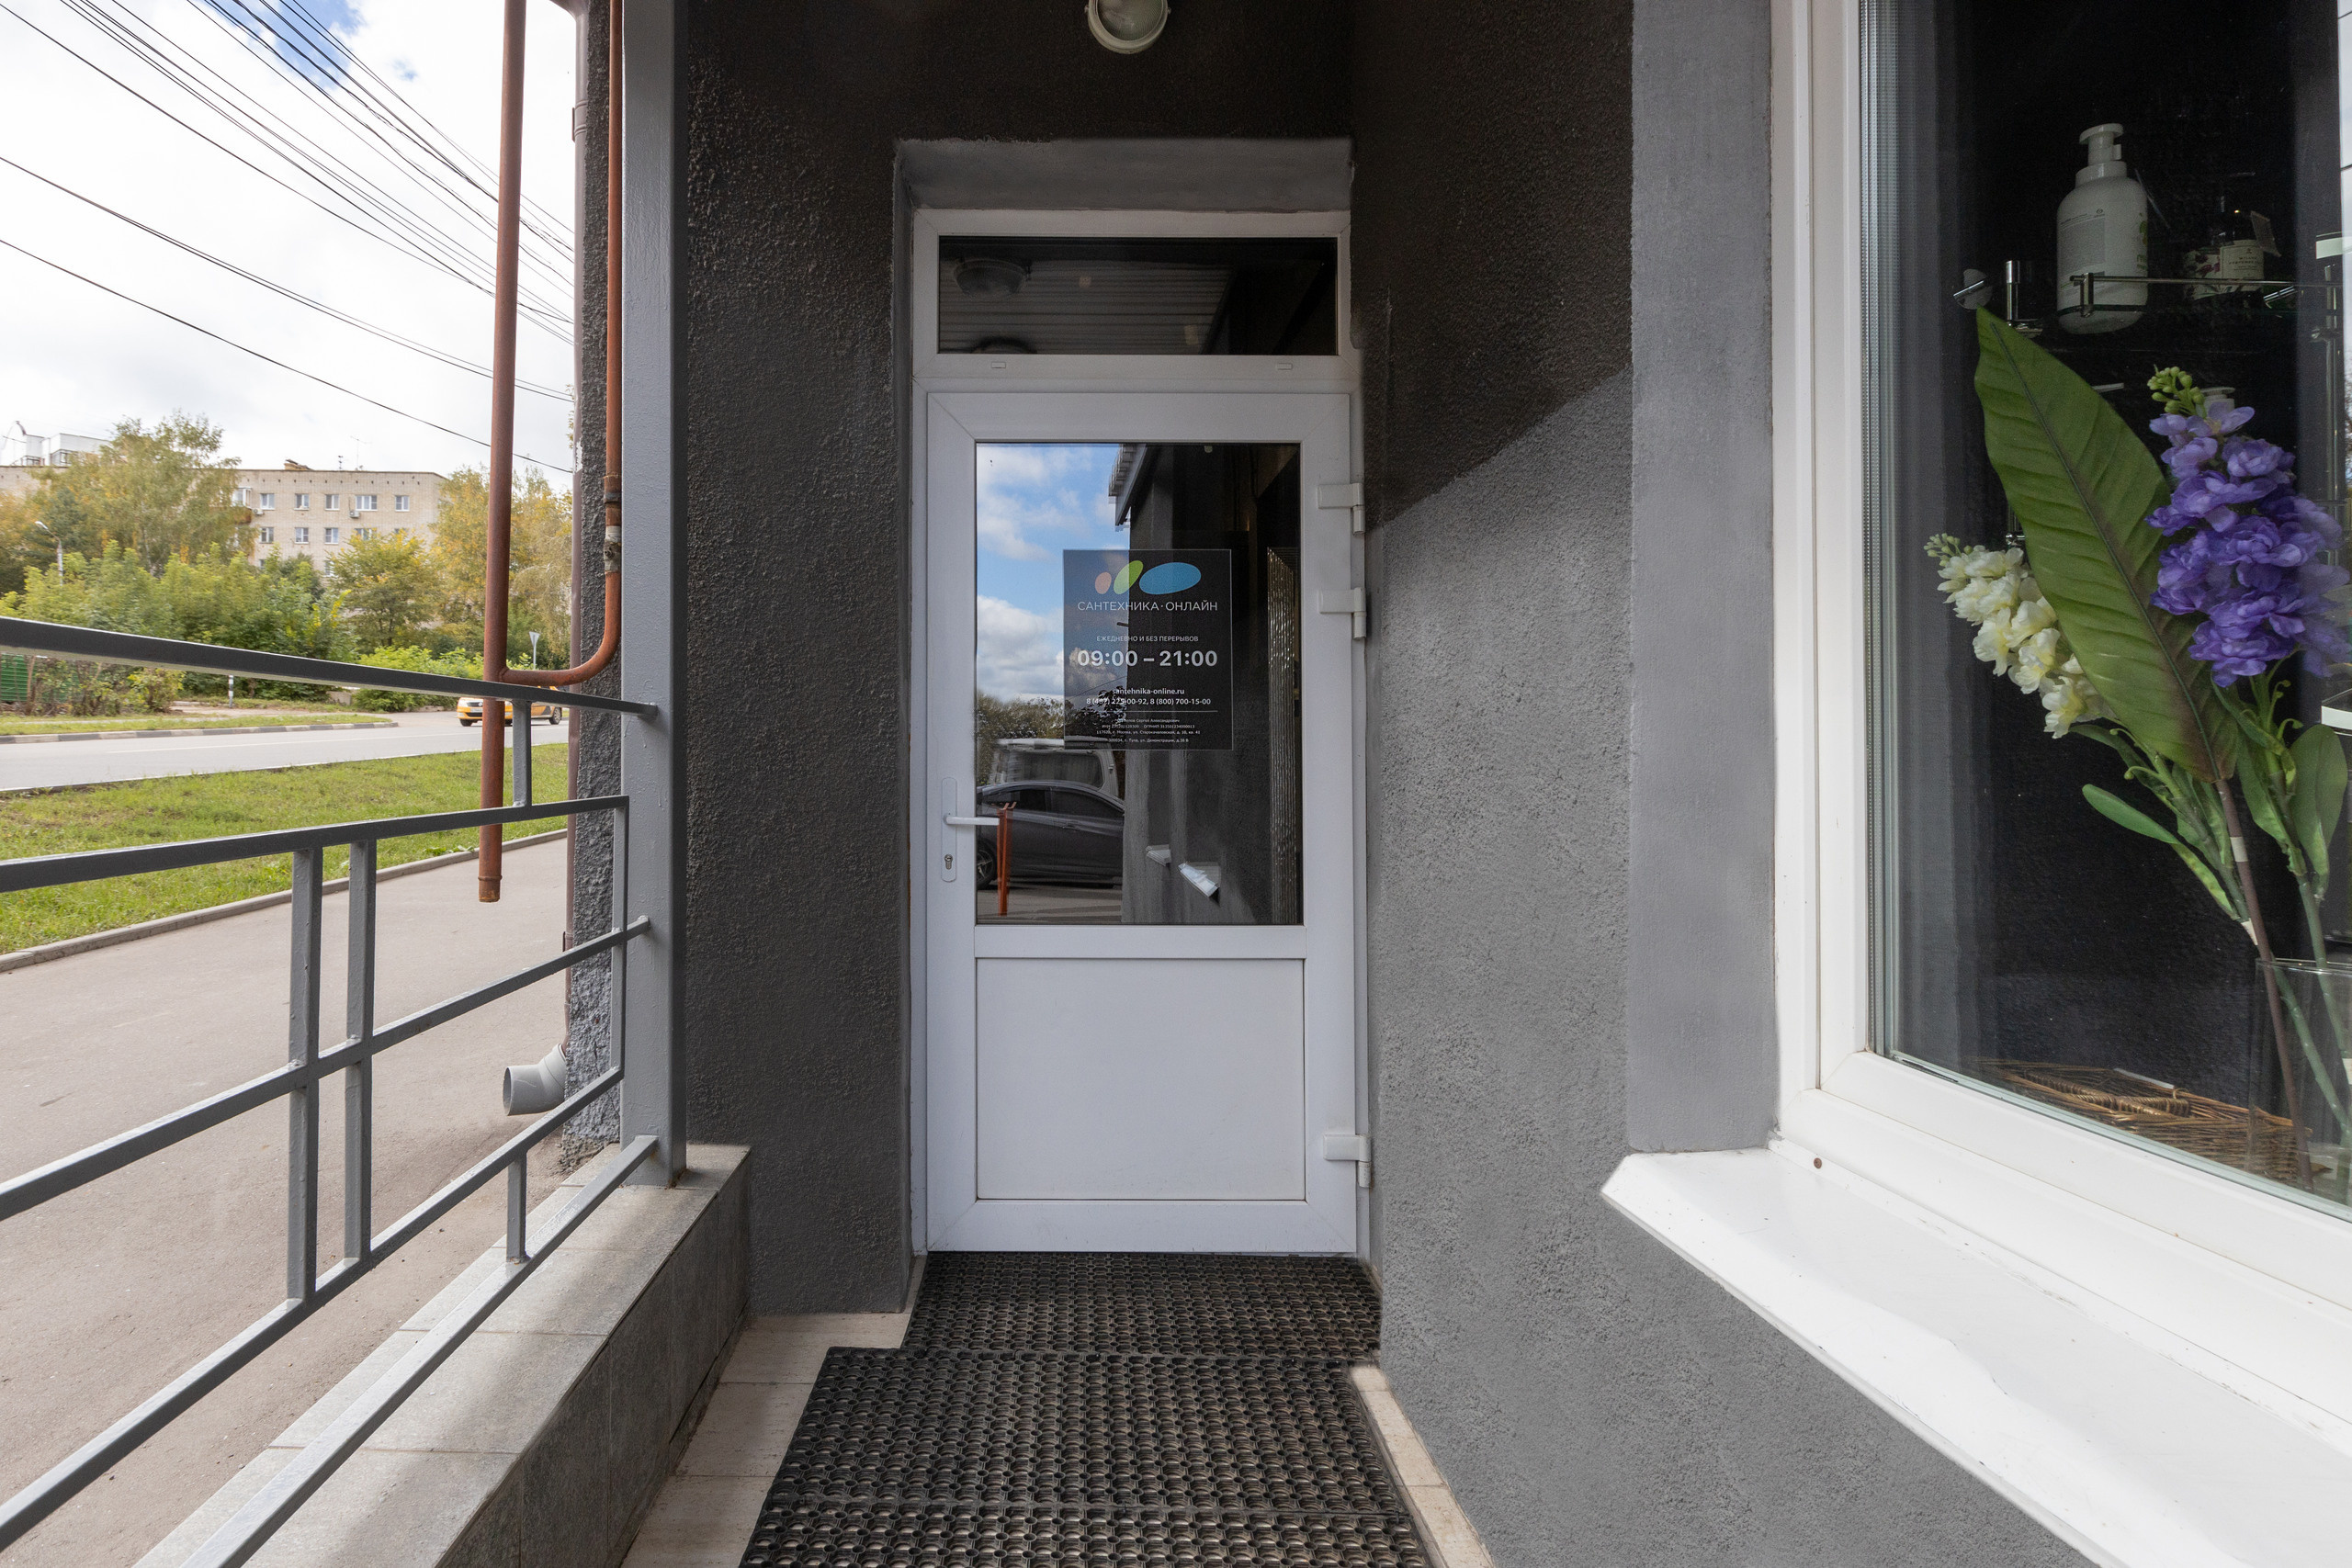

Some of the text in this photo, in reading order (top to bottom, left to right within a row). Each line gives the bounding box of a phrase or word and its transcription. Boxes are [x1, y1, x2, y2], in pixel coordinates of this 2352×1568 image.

[1077, 649, 1138, 667] 09:00
[1159, 649, 1217, 667] 21:00
[1112, 687, 1185, 695] santehnika-online.ru
[1156, 698, 1174, 706] (800)
